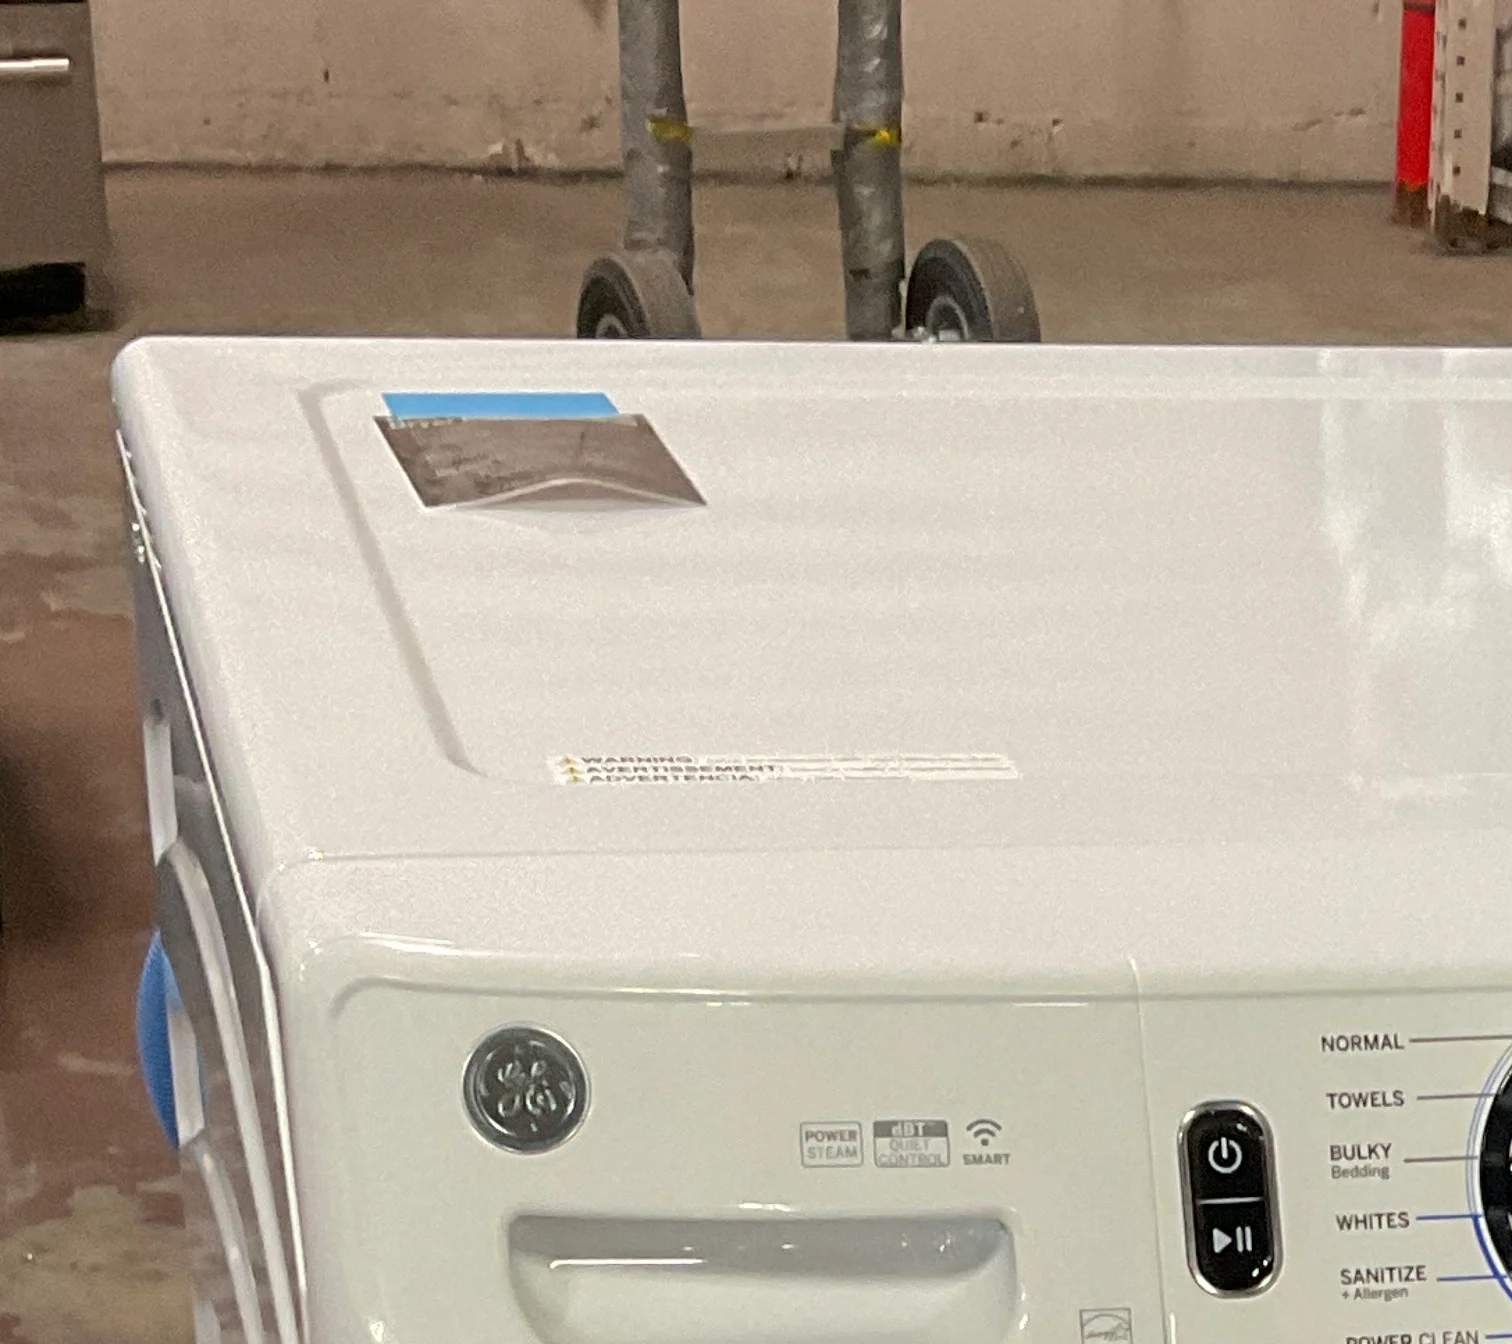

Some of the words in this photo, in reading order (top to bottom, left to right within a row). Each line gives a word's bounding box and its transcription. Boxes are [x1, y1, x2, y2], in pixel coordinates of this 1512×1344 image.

[1320, 1033, 1405, 1052] NORMAL
[1326, 1090, 1405, 1109] TOWELS
[805, 1129, 857, 1142] POWER
[807, 1146, 858, 1160] STEAM
[889, 1139, 929, 1152] QUIET
[1329, 1142, 1392, 1161] BULKY
[878, 1153, 944, 1167] CONTROL
[963, 1153, 1011, 1166] SMART
[1331, 1164, 1390, 1181] Bedding
[1335, 1211, 1410, 1231] WHITES
[1339, 1264, 1428, 1286] SANITIZE
[1353, 1287, 1409, 1302] Allergen
